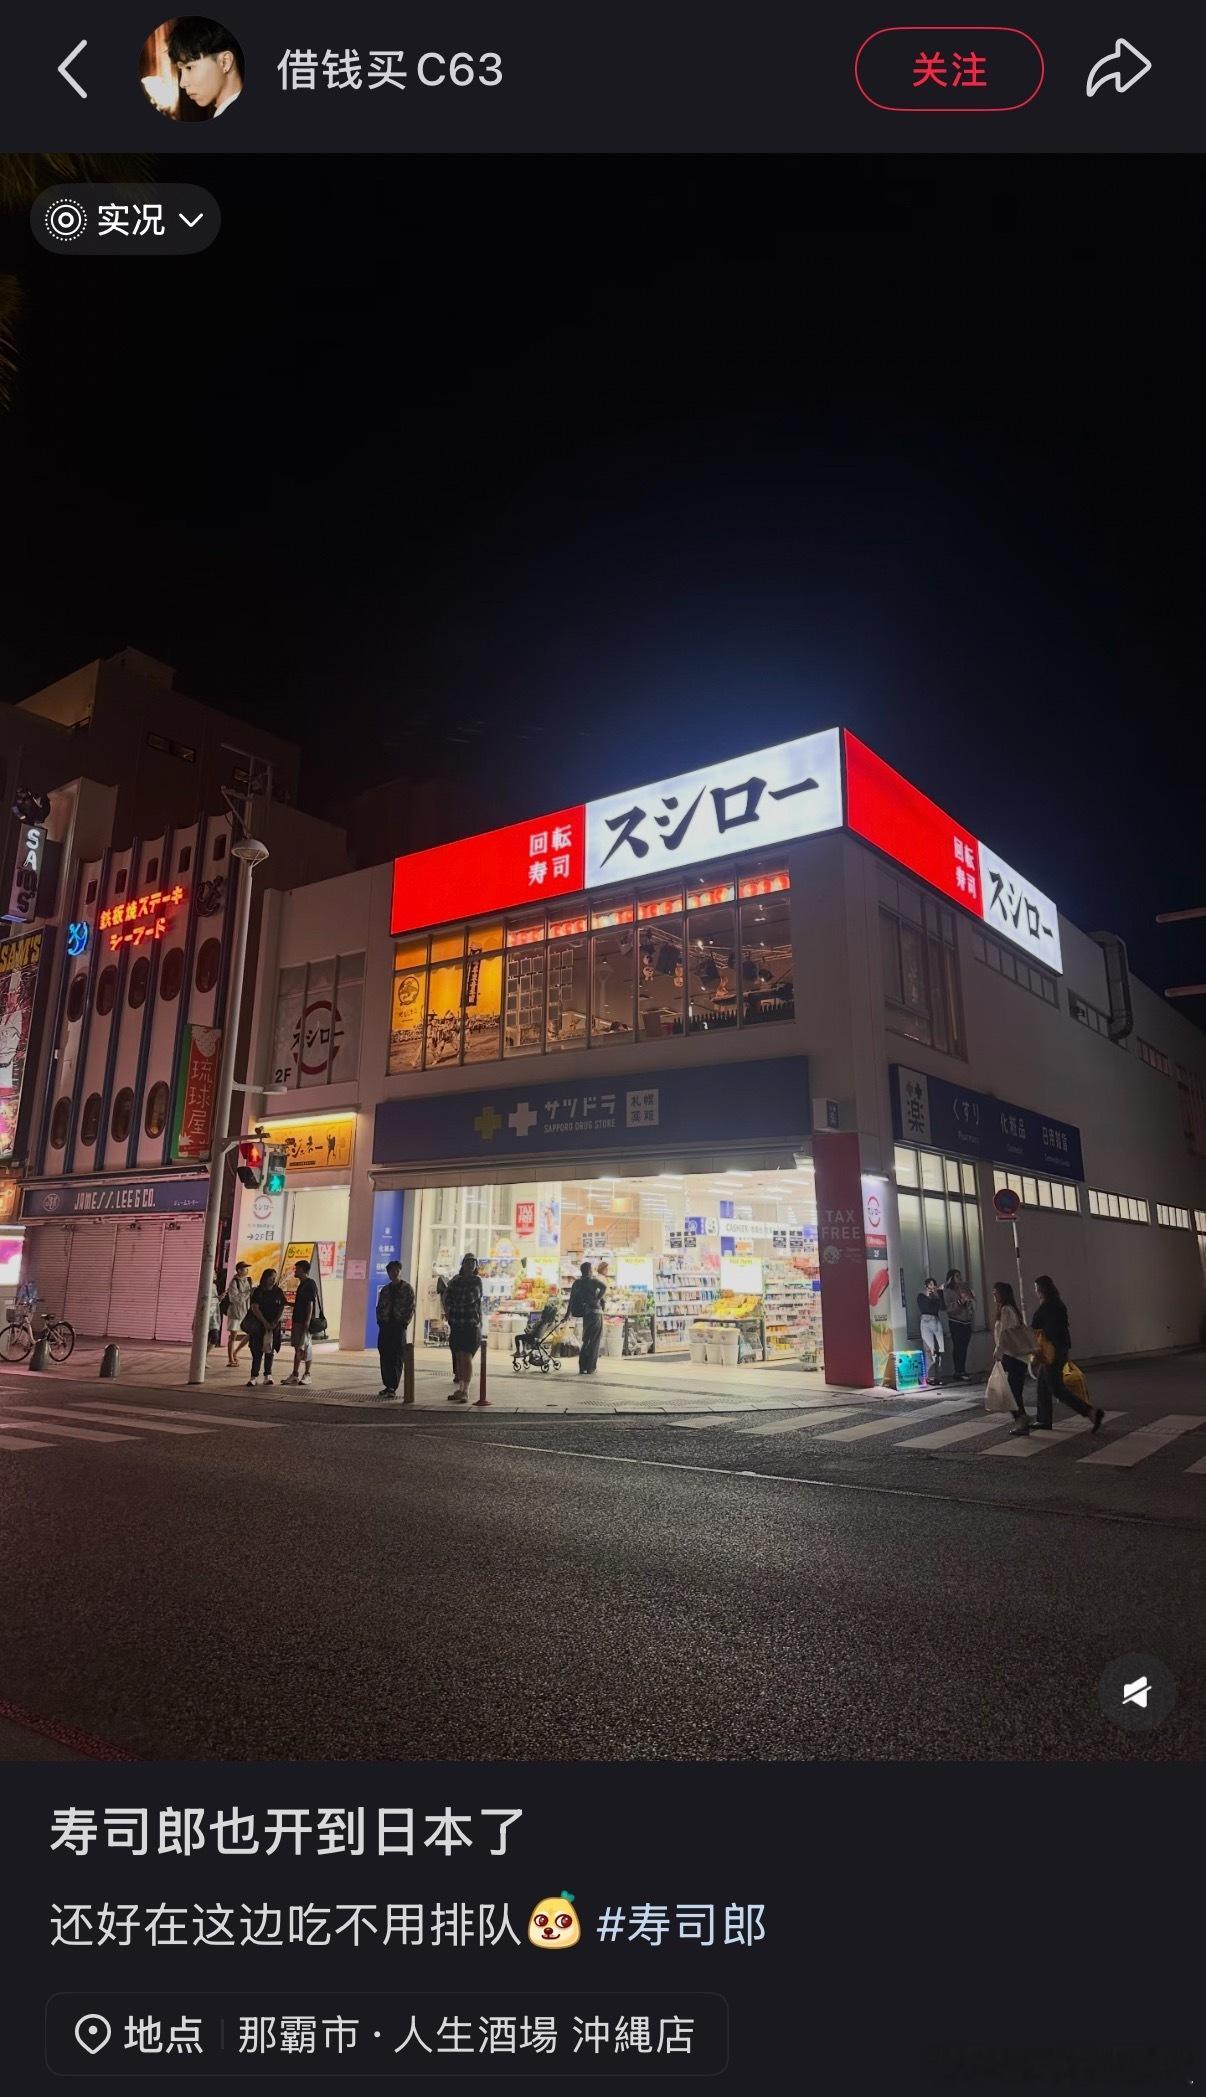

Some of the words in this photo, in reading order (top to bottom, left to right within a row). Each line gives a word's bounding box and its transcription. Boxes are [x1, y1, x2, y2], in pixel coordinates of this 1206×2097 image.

[600, 776, 819, 868] スシロー
[529, 826, 572, 856] 回転
[528, 855, 570, 885] 寿司
[988, 868, 1054, 940] スシロー
[109, 917, 166, 951] シーフード
[291, 1026, 345, 1050] スシロー
[275, 1067, 292, 1084] 2F
[188, 1059, 214, 1135] 琉球屋
[545, 1094, 616, 1120] サツドラ
[953, 1097, 979, 1125] くすり
[544, 1120, 573, 1133] SAPPORO
[574, 1119, 592, 1130] DRUG
[594, 1118, 616, 1129] STORE
[1000, 1111, 1026, 1139] 化粧品
[116, 1190, 133, 1208] LEE
[142, 1187, 156, 1208] CO.
[518, 1205, 534, 1215] TAX
[824, 1210, 855, 1223] TAX
[821, 1226, 860, 1240] FREE
